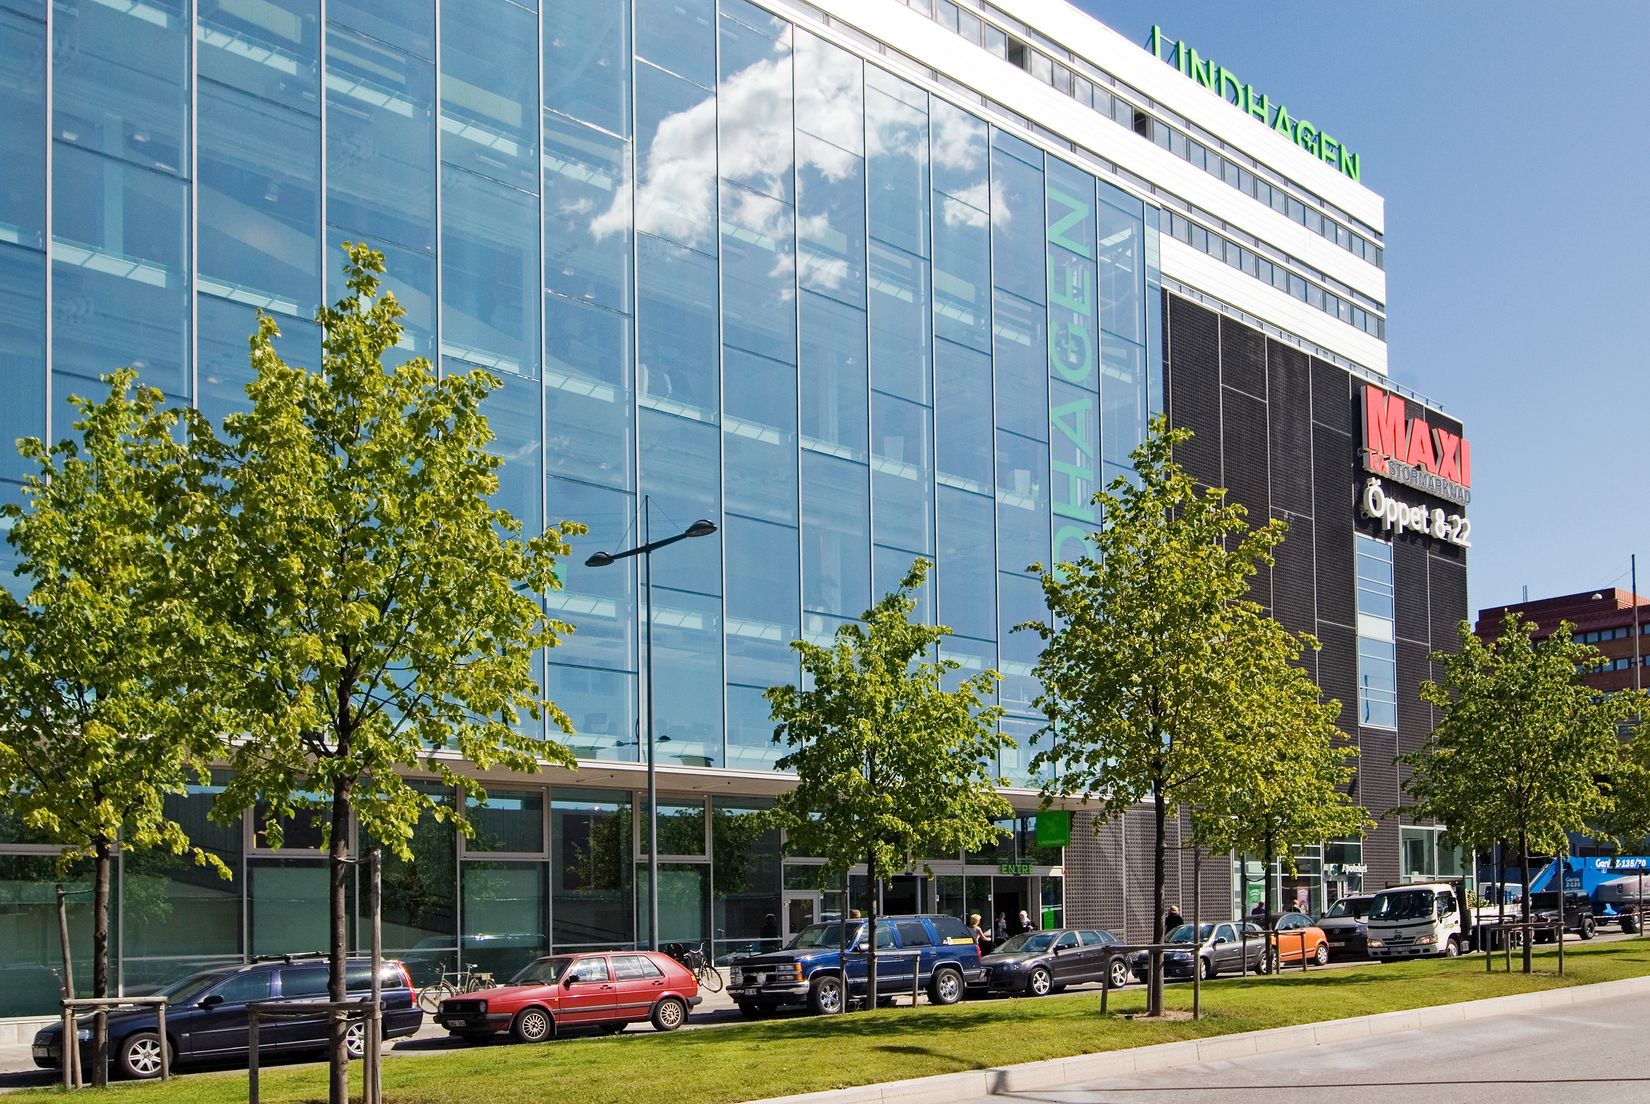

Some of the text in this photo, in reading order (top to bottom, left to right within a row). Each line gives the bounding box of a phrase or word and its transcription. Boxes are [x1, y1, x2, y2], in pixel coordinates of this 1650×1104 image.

[1364, 385, 1471, 489] MAXI
[1364, 476, 1472, 548] Öppet 8-22
[1388, 460, 1472, 504] STORMARKNAD
